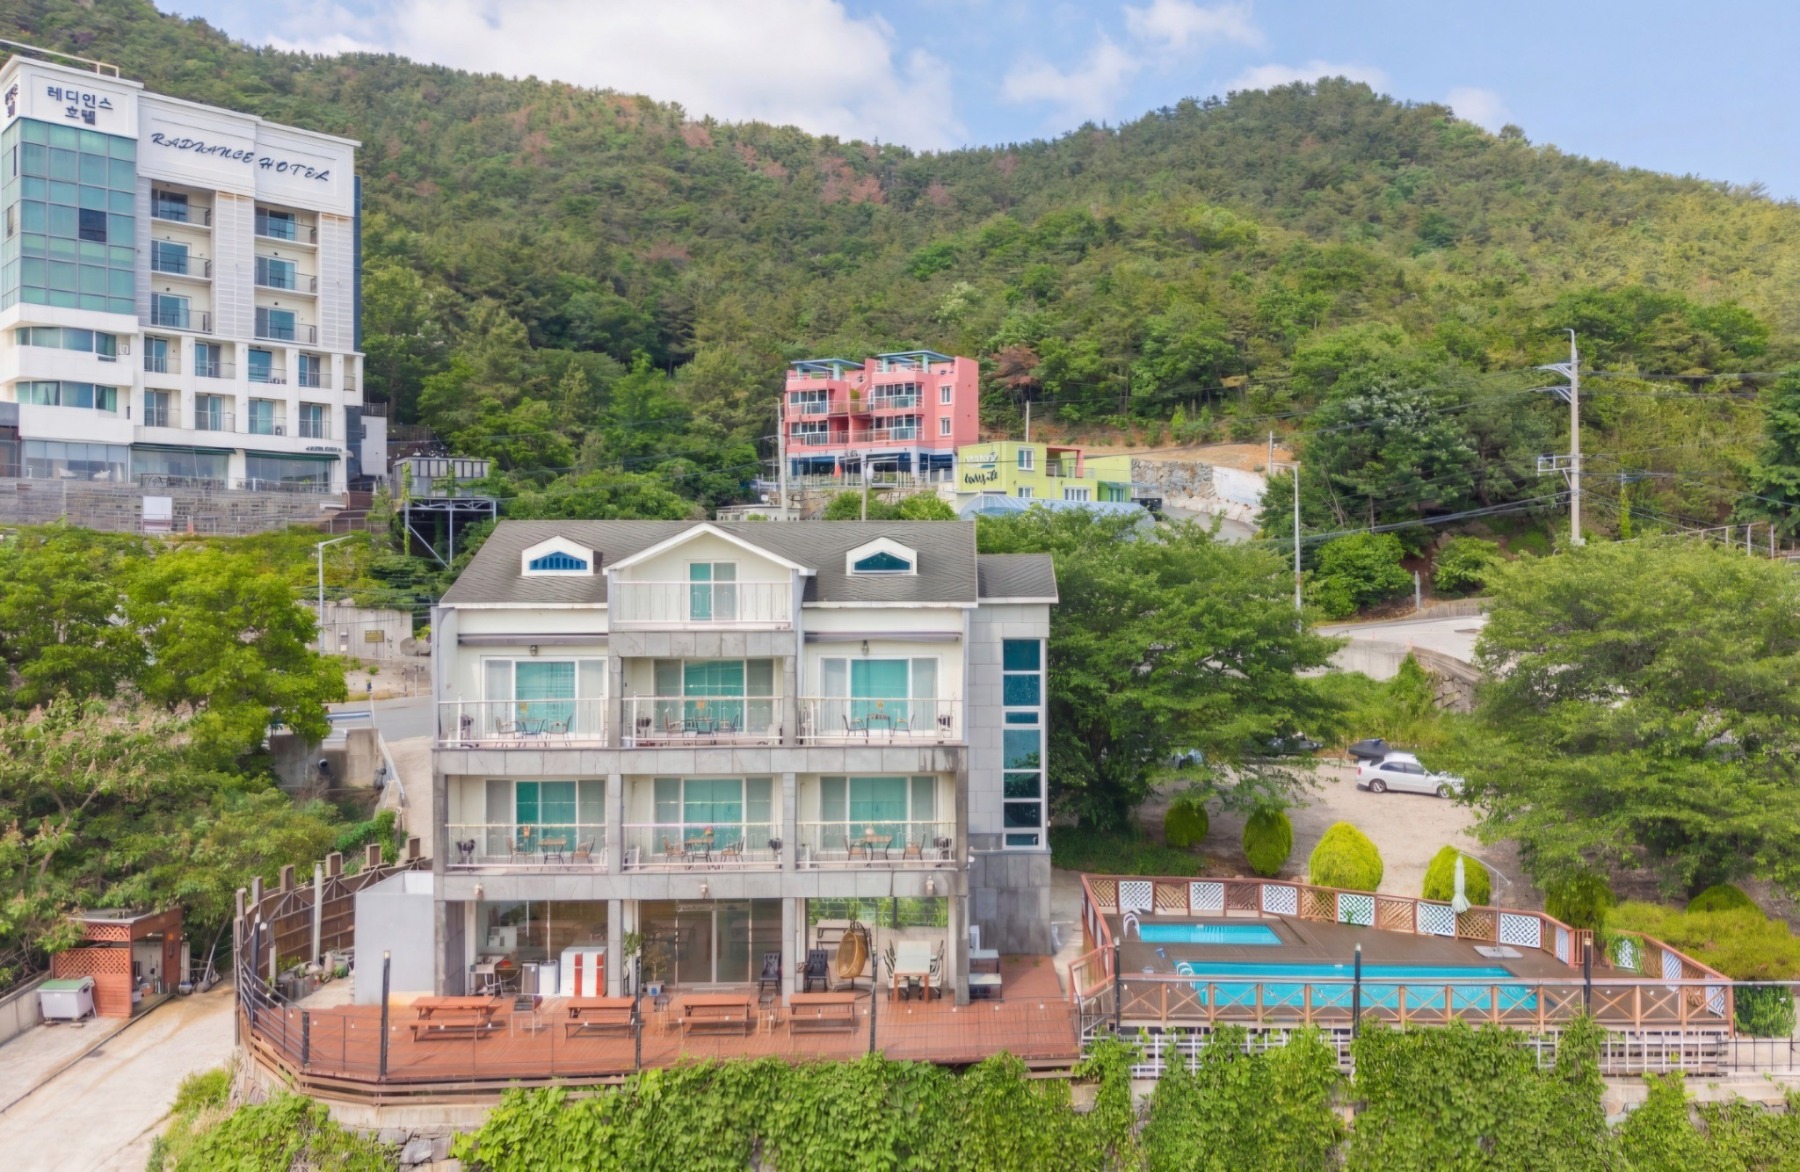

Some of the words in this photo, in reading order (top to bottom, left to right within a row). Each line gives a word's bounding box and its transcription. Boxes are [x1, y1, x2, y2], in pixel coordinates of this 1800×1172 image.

[47, 86, 114, 110] 레디인스
[65, 105, 96, 126] 호텔
[151, 132, 255, 163] RADIANCE
[258, 157, 331, 182] HOTEL
